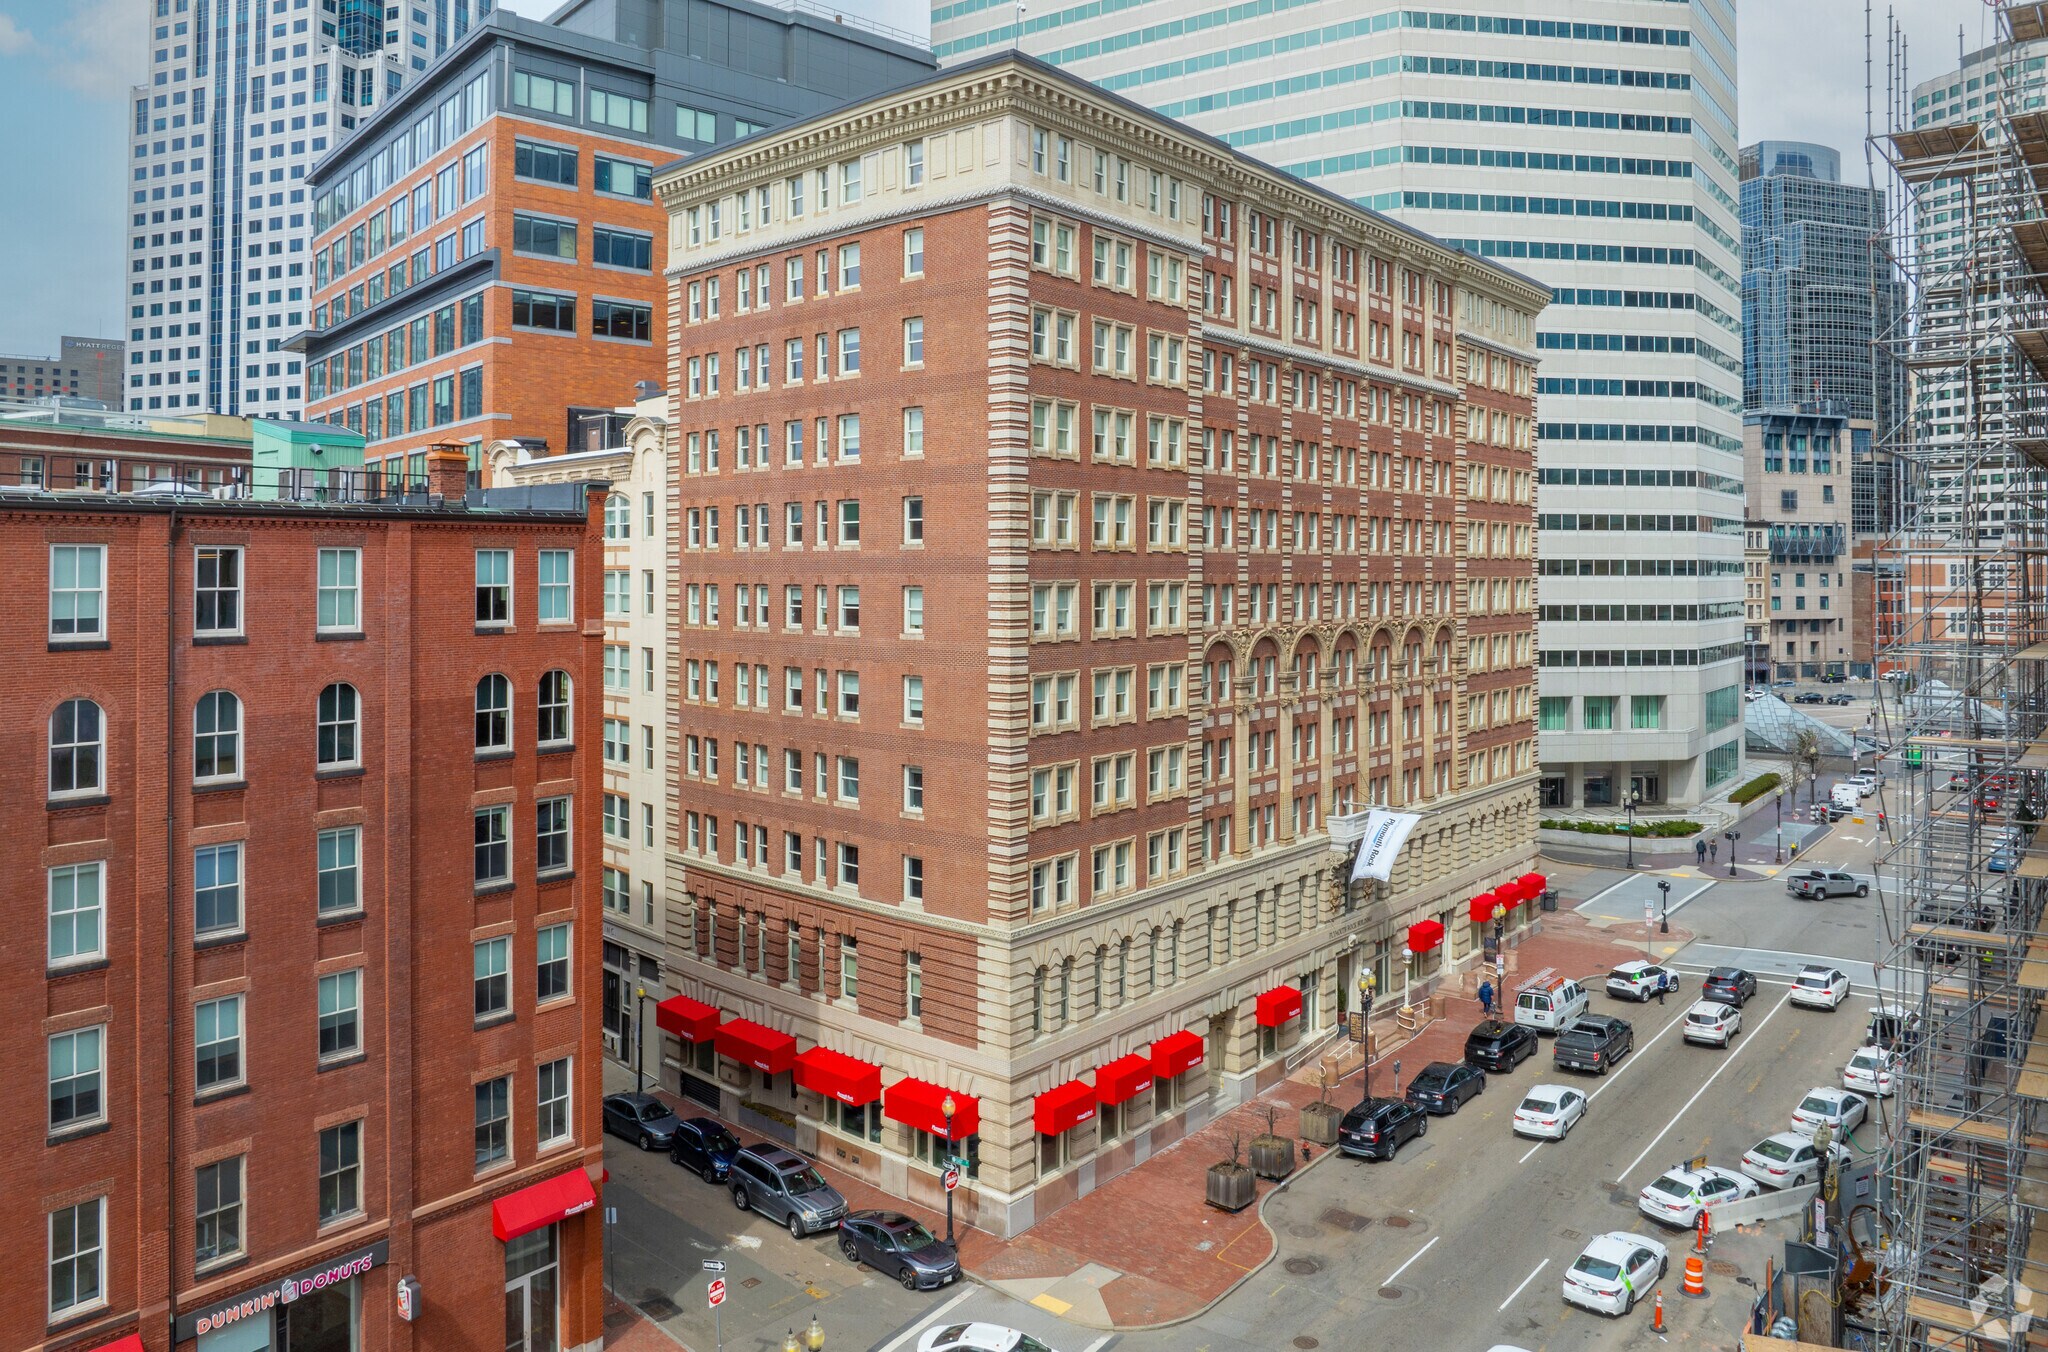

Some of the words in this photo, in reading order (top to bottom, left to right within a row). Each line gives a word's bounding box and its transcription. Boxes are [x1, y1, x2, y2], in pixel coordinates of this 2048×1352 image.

[1374, 818, 1396, 849] Plymouth
[1366, 849, 1380, 867] Rock
[196, 1289, 281, 1336] DUNKIN'
[300, 1255, 373, 1295] DONUTS
